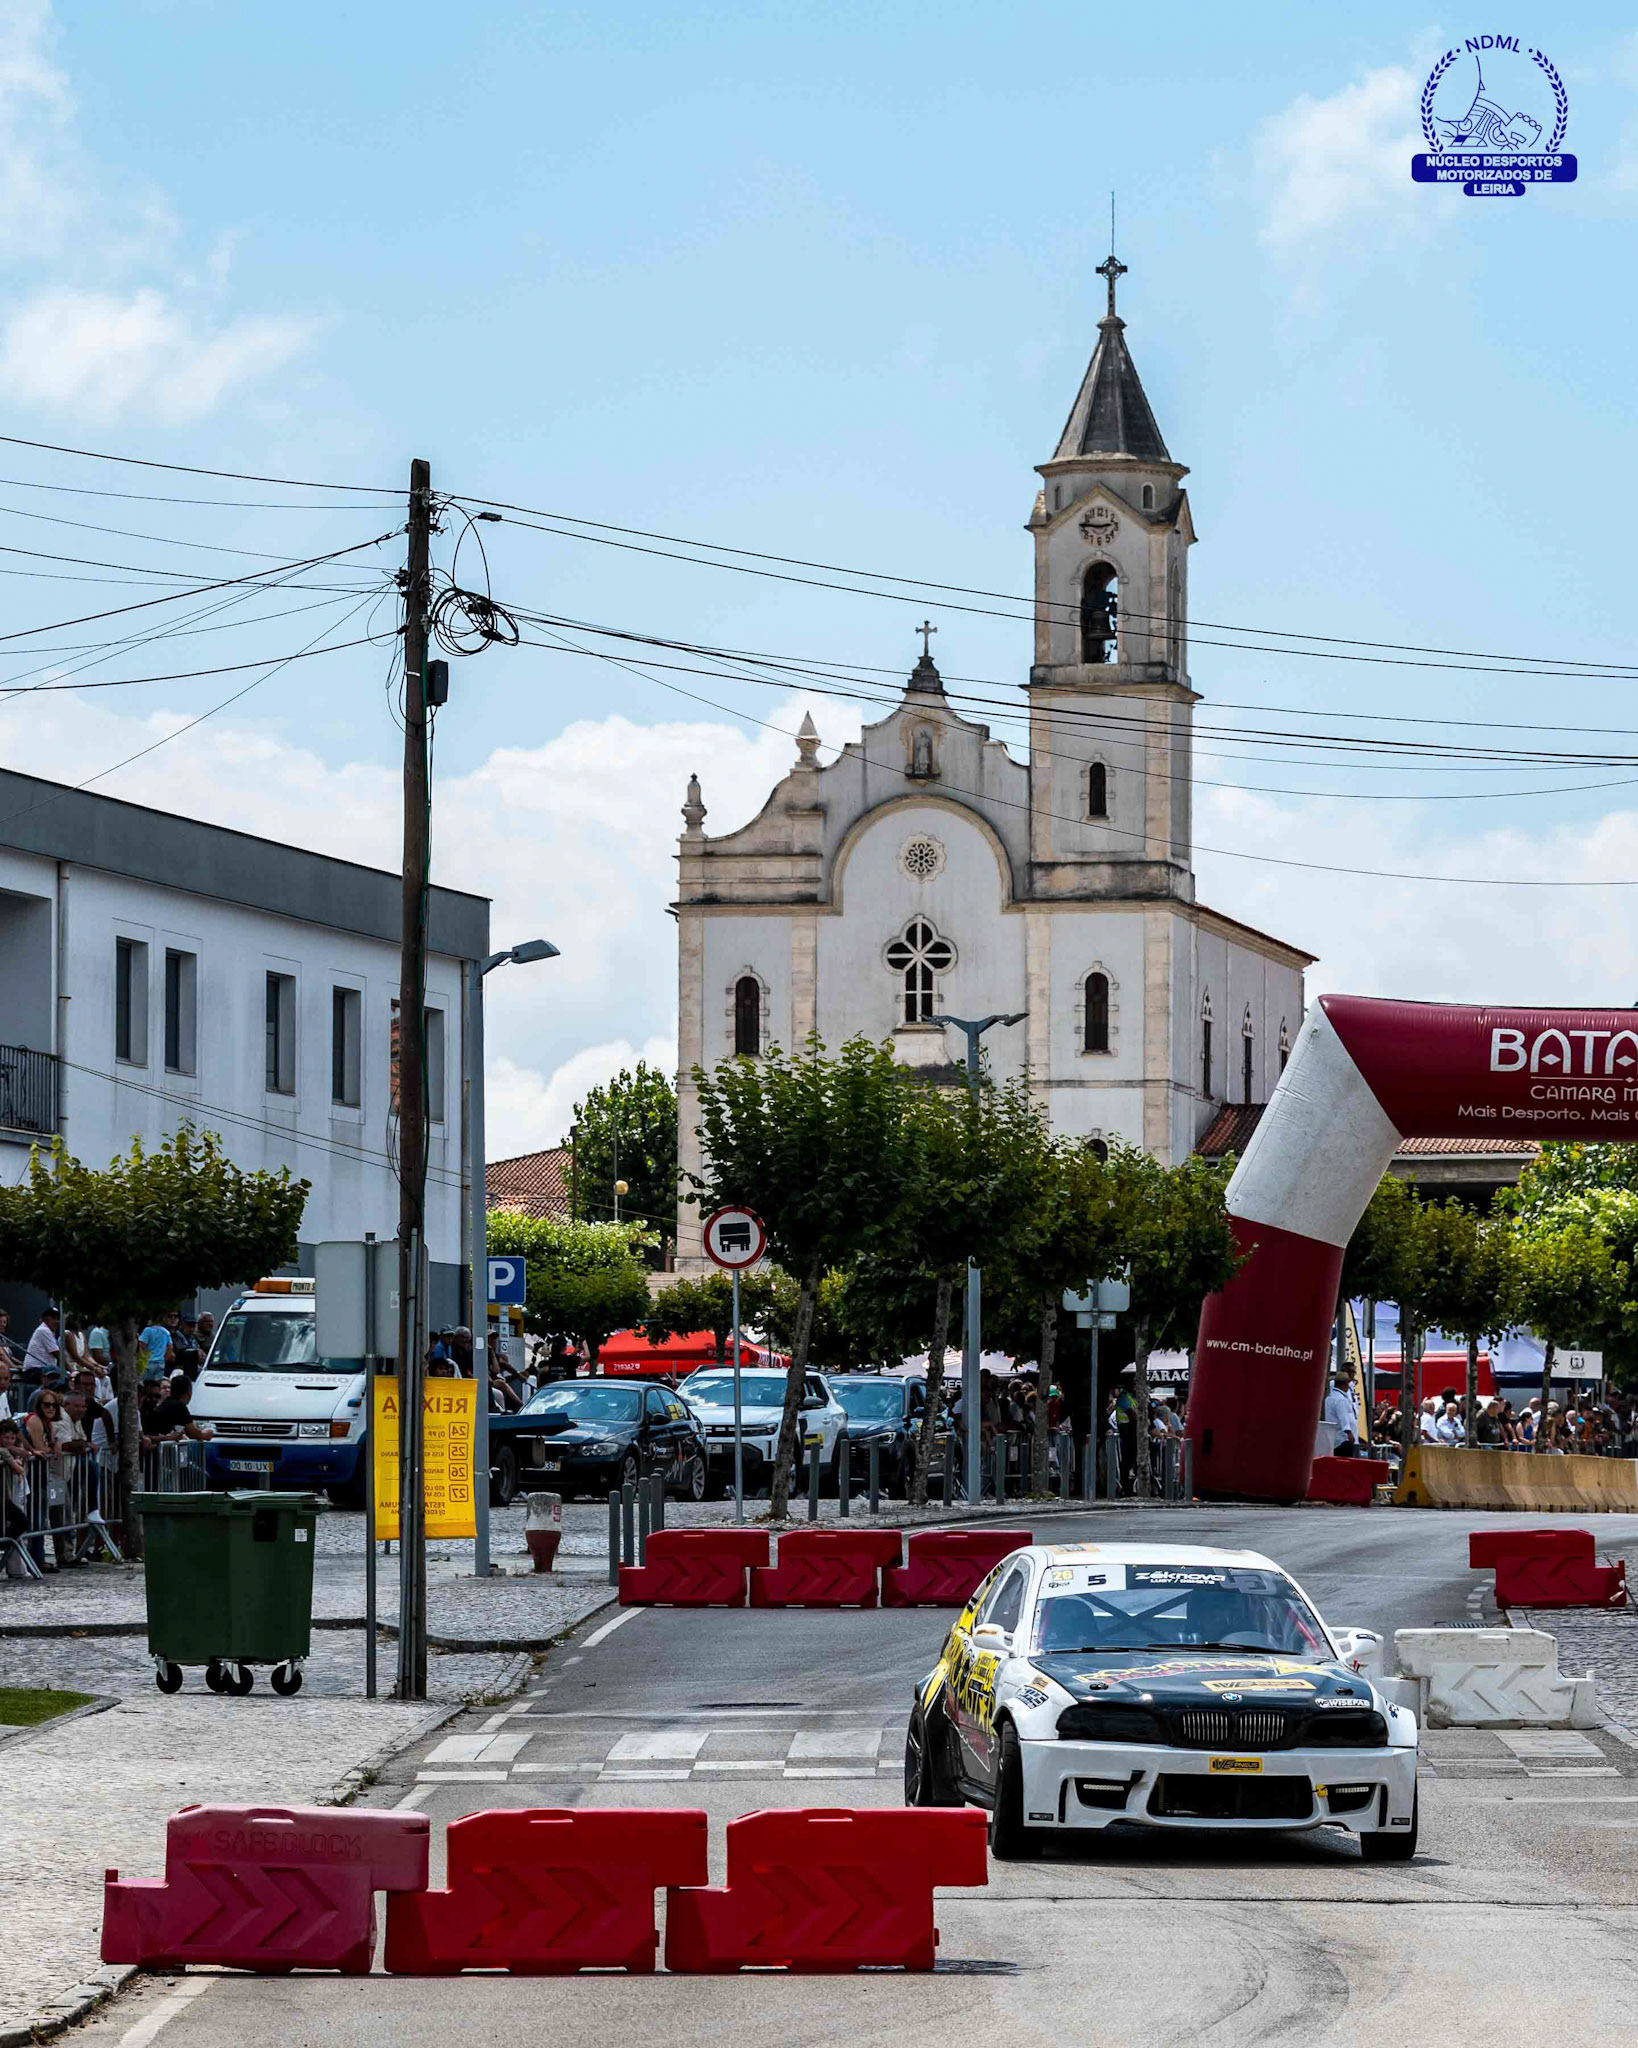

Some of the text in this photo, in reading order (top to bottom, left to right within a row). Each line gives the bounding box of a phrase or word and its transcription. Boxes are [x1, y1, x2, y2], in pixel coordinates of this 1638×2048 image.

[1457, 1105, 1497, 1118] Mais
[1501, 1107, 1585, 1121] Desporto.
[1590, 1109, 1630, 1122] Mais
[488, 1261, 516, 1299] P
[205, 1373, 349, 1383] PRONTO SOCORRO
[1146, 1370, 1189, 1382] ARAG
[1088, 1574, 1107, 1587] 5
